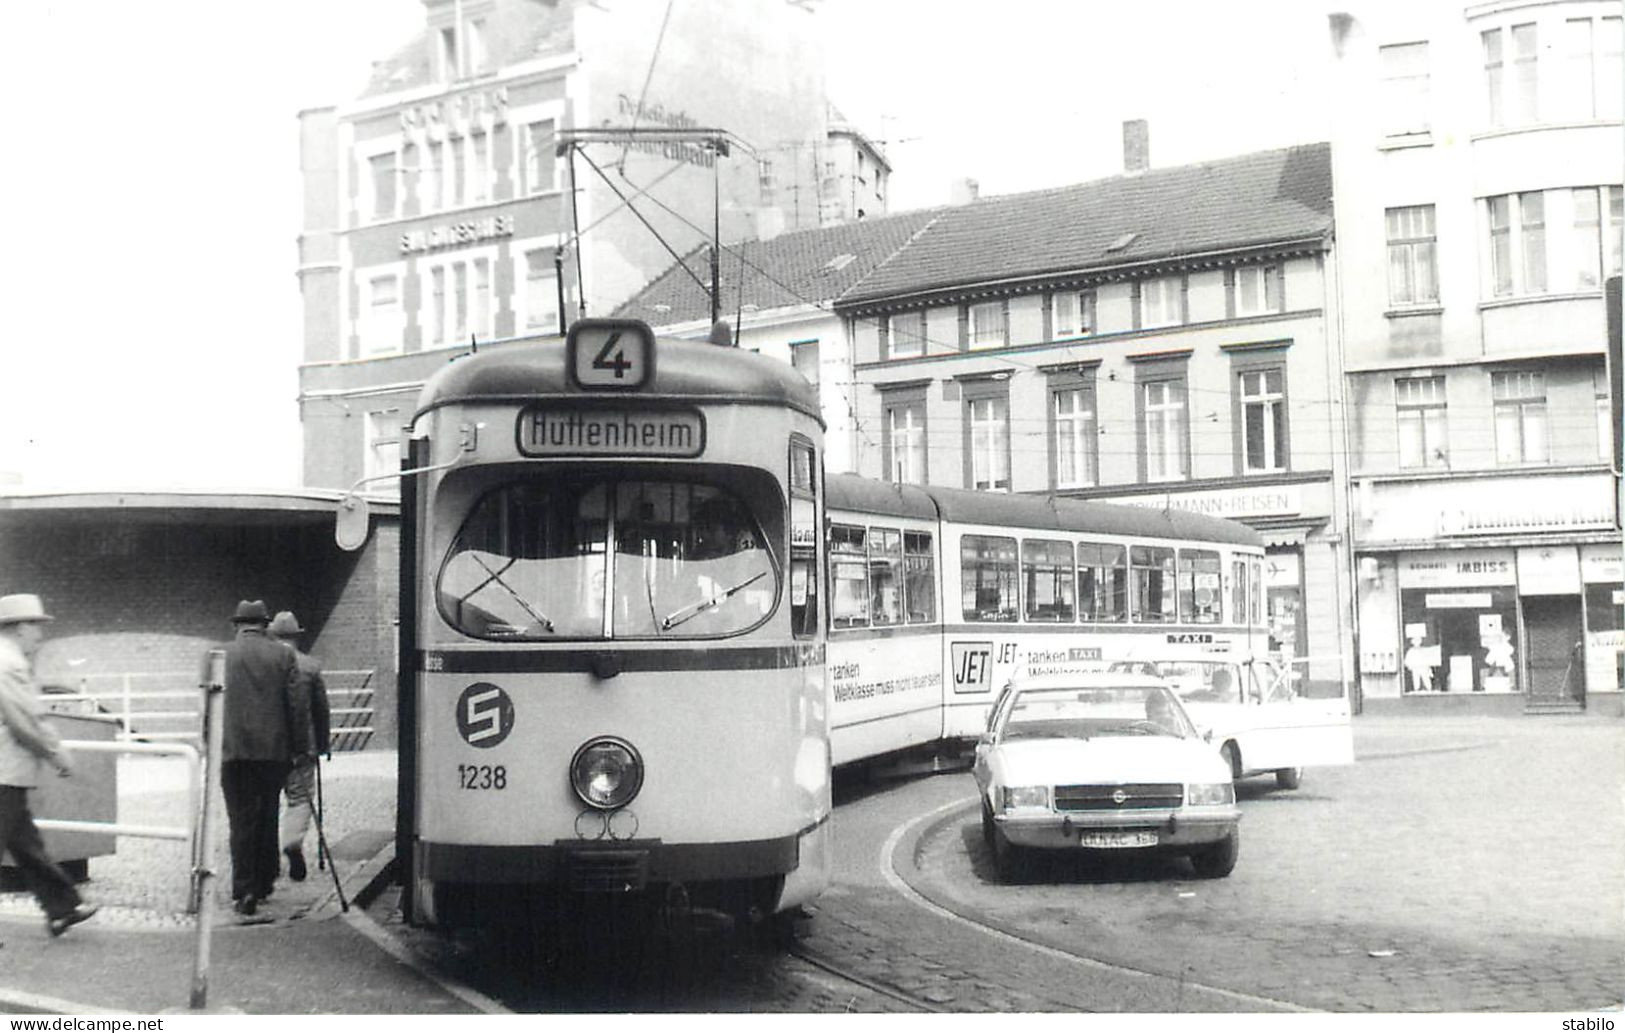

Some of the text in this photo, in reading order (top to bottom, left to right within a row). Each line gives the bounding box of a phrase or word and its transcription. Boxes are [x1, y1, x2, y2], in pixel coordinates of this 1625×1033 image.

[592, 333, 632, 379] 4
[1456, 560, 1509, 573] IMBISS
[1028, 649, 1066, 664] tanken
[1072, 649, 1098, 660] TAXI
[956, 651, 989, 684] JET
[833, 682, 875, 702] Weltklasse
[876, 679, 894, 694] muss
[458, 764, 507, 790] 1238
